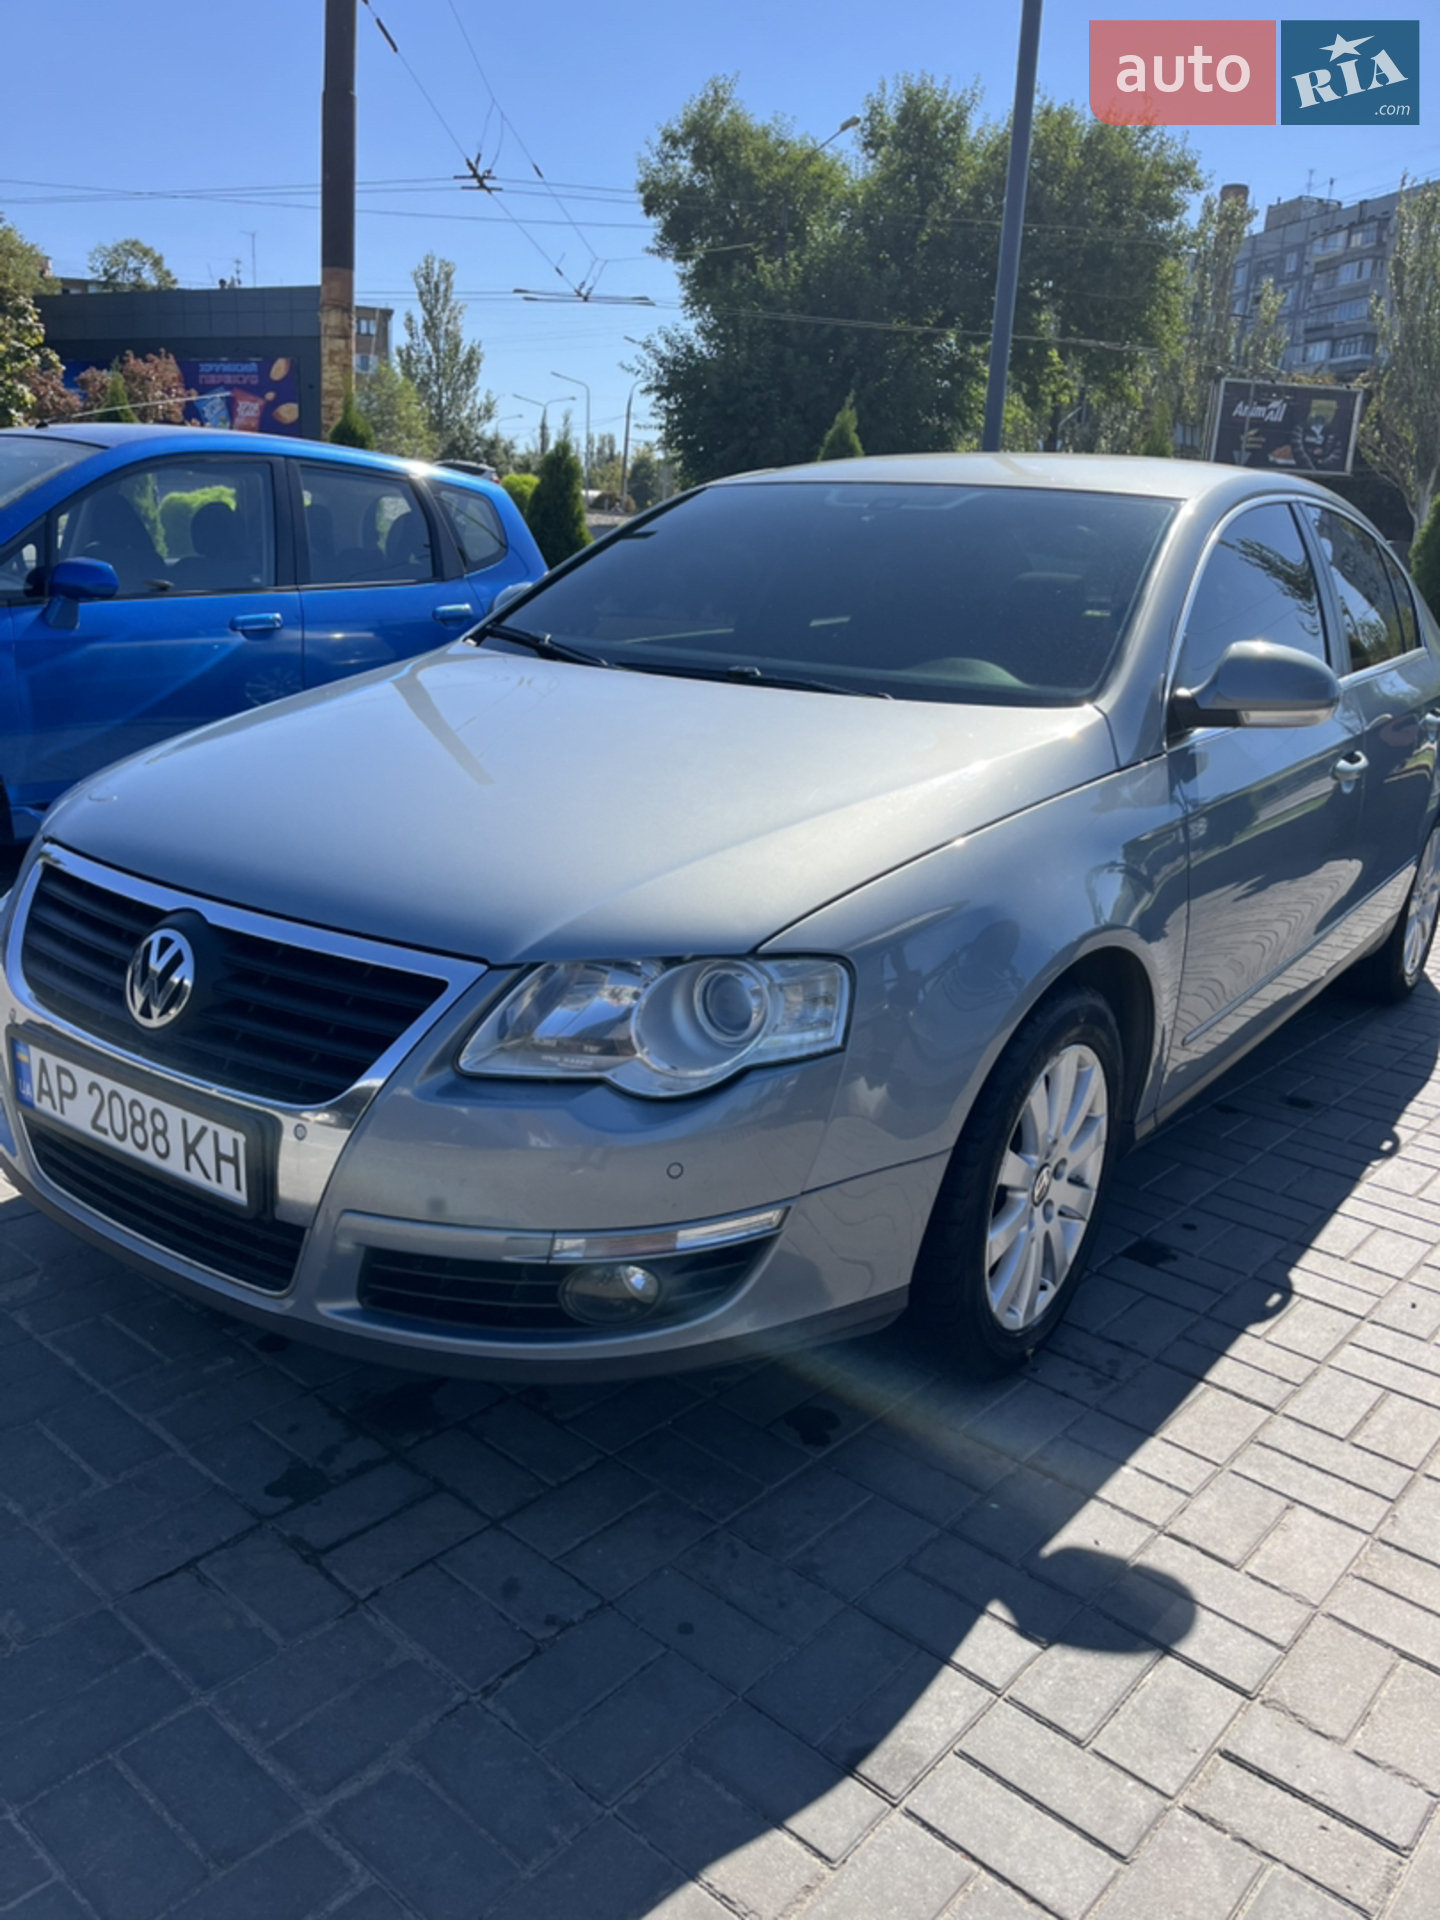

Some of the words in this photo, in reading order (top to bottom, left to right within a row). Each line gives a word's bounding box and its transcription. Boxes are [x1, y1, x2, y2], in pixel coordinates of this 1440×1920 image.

[37, 1058, 78, 1115] AP
[87, 1081, 171, 1160] 2088
[181, 1117, 242, 1192] KH
